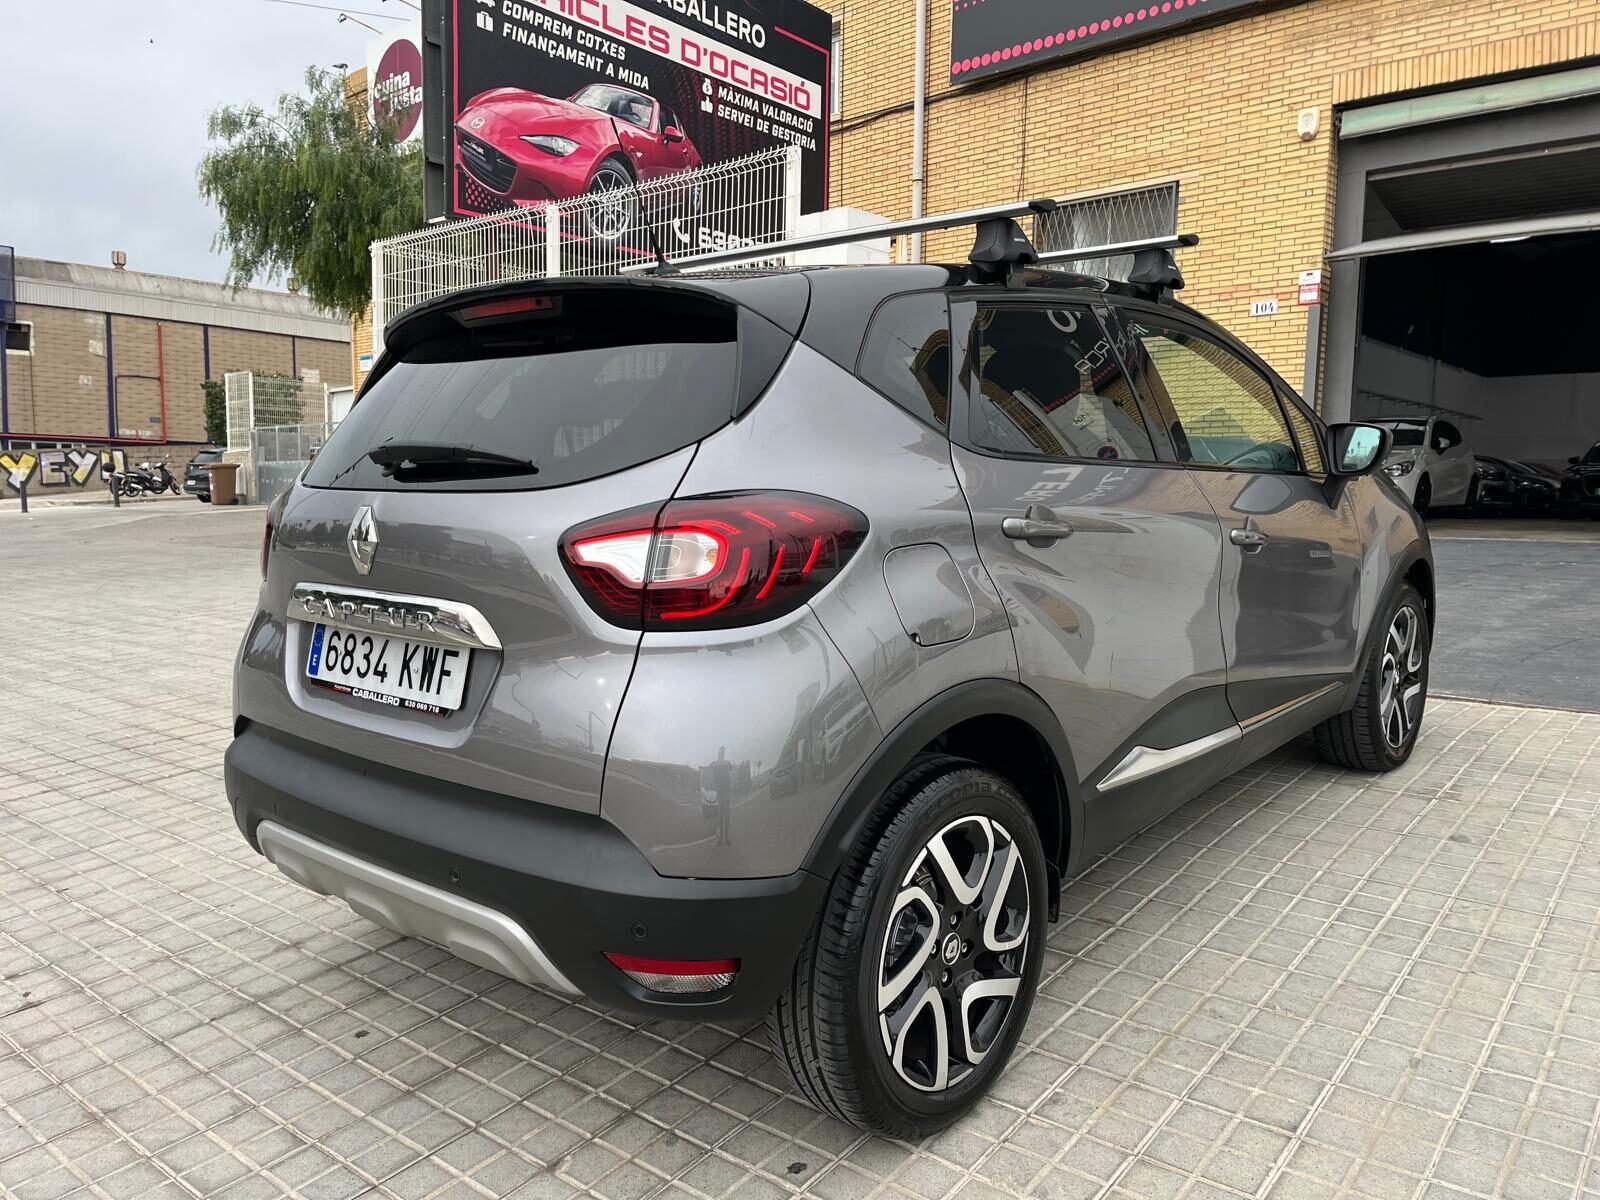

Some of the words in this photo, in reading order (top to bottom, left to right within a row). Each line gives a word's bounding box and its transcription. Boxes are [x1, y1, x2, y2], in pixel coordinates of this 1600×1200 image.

[502, 0, 573, 40] COMPREM
[576, 29, 626, 61] COTXES
[502, 22, 603, 73] FINANÇAMENT
[605, 62, 615, 78] A
[618, 66, 650, 91] MIDA
[680, 37, 811, 112] D'OCASIÓ
[717, 86, 760, 113] MÀXIMA
[762, 102, 814, 133] VALORACIÓ
[717, 104, 754, 128] SERVEI
[756, 118, 770, 134] DE
[771, 124, 817, 152] GESTORIA
[1254, 302, 1274, 314] 104
[302, 595, 437, 633] CAPTUR
[311, 653, 319, 666] E
[324, 630, 391, 684] 6834
[398, 642, 460, 695] KWF
[351, 688, 401, 707] CABALLERO
